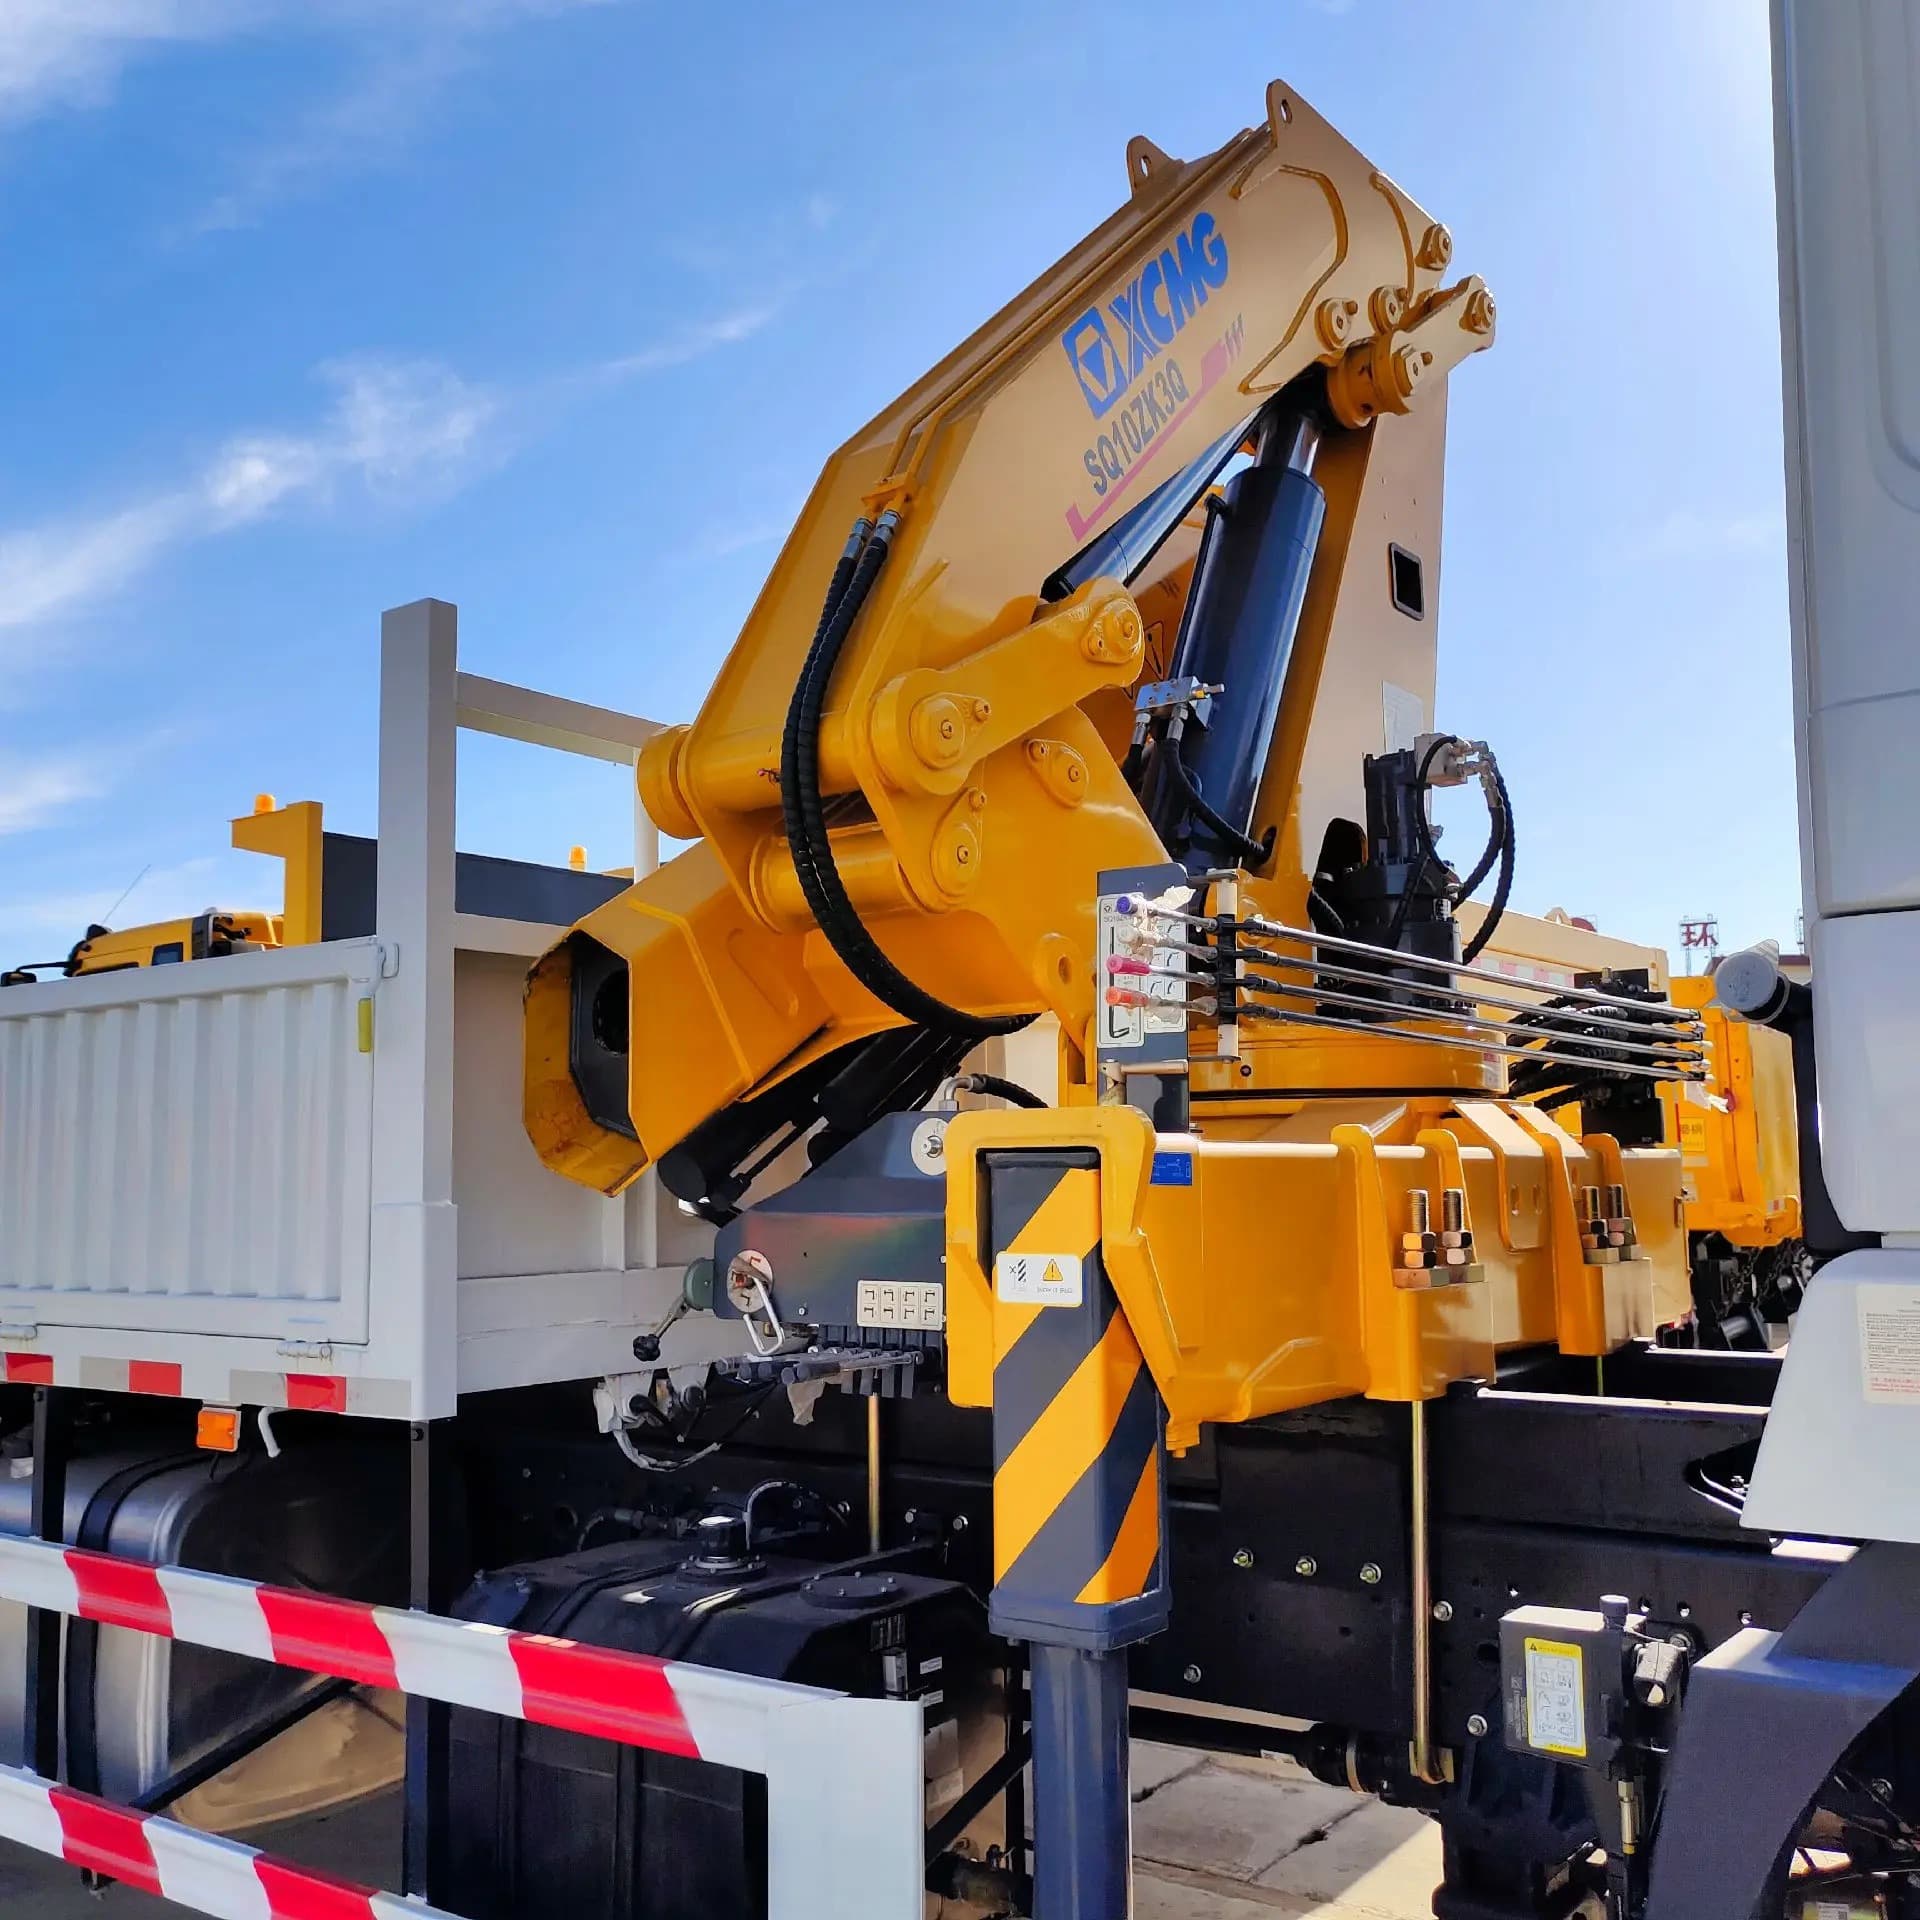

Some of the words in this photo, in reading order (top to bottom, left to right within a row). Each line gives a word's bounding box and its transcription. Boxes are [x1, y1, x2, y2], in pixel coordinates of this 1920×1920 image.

[1109, 212, 1229, 384] XCMG
[1084, 359, 1189, 495] SQ10ZK3Q
[1680, 921, 1718, 946] 环
